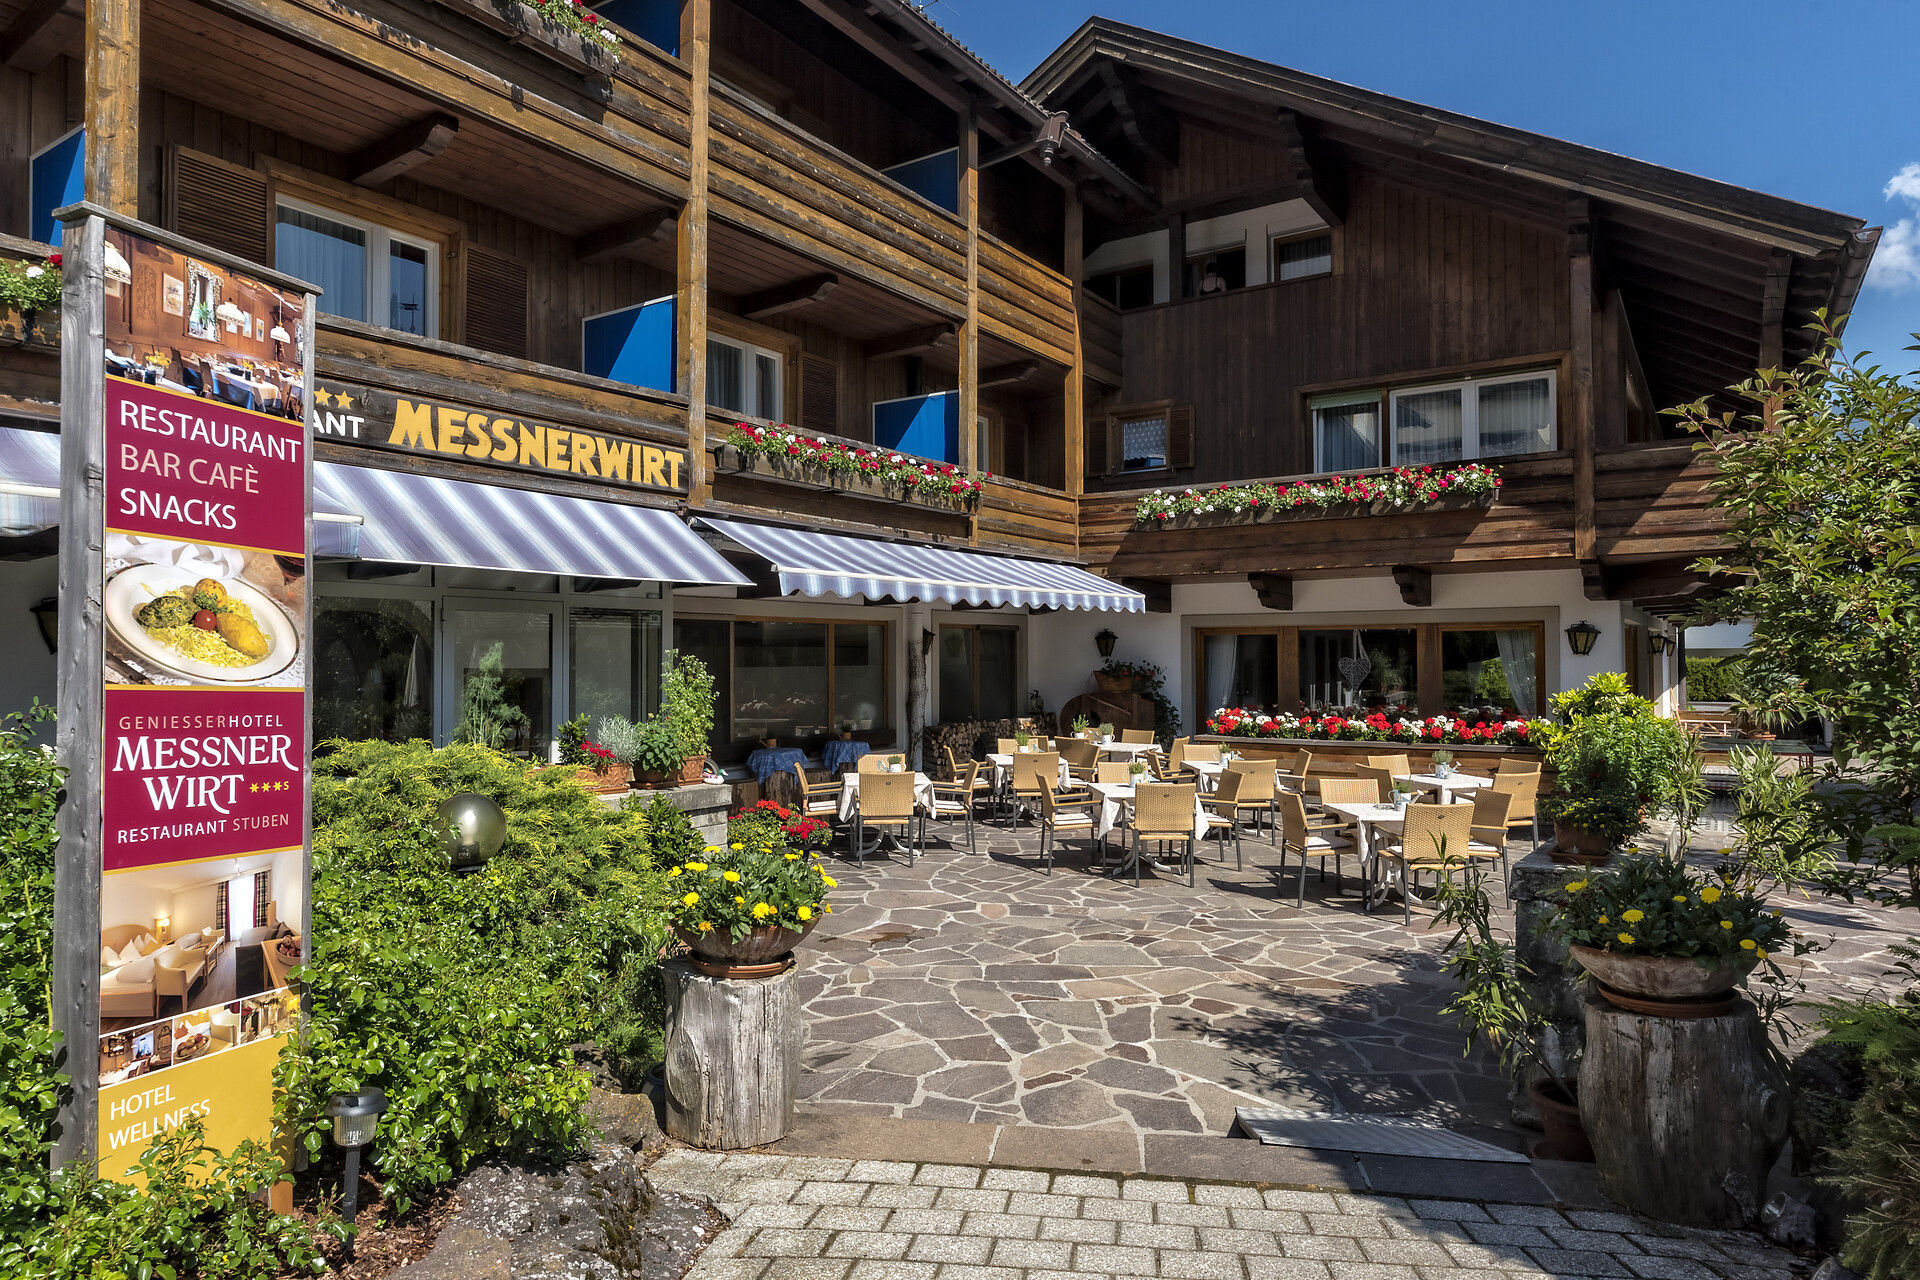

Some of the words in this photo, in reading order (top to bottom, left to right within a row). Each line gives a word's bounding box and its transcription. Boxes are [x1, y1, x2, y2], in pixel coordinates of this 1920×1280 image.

[120, 400, 302, 463] RESTAURANT
[388, 399, 685, 489] MESSNERWIRT
[120, 443, 182, 480] BAR
[189, 463, 259, 494] CAFÈ
[119, 487, 238, 530] SNACKS
[118, 714, 283, 730] GENIESSERHOTEL
[112, 734, 299, 772] MESSNER
[142, 774, 245, 815] WIRT
[117, 819, 227, 844] RESTAURANT
[232, 813, 289, 832] STUBEN
[110, 1084, 176, 1121] HOTEL
